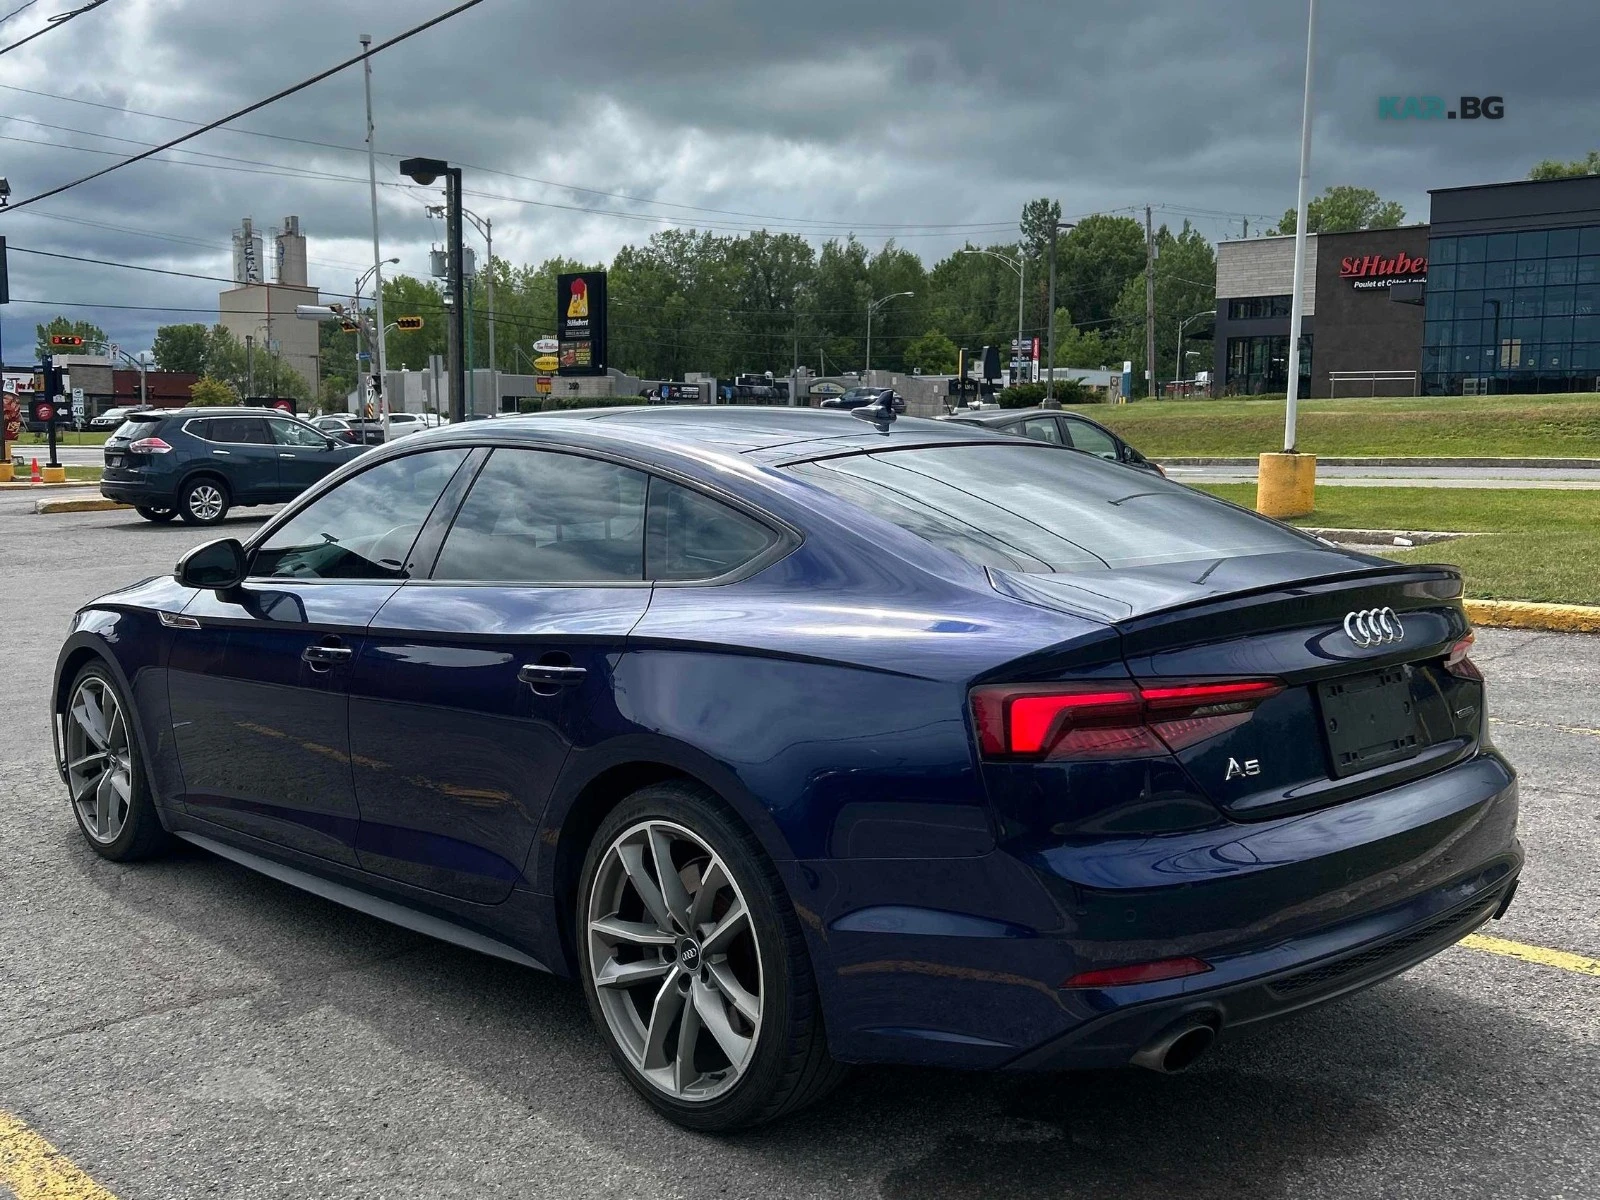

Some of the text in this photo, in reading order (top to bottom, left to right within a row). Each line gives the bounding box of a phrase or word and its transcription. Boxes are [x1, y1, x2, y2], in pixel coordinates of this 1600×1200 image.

[1354, 280, 1376, 289] Poulet
[73, 406, 84, 415] 40
[1225, 757, 1261, 781] A5
